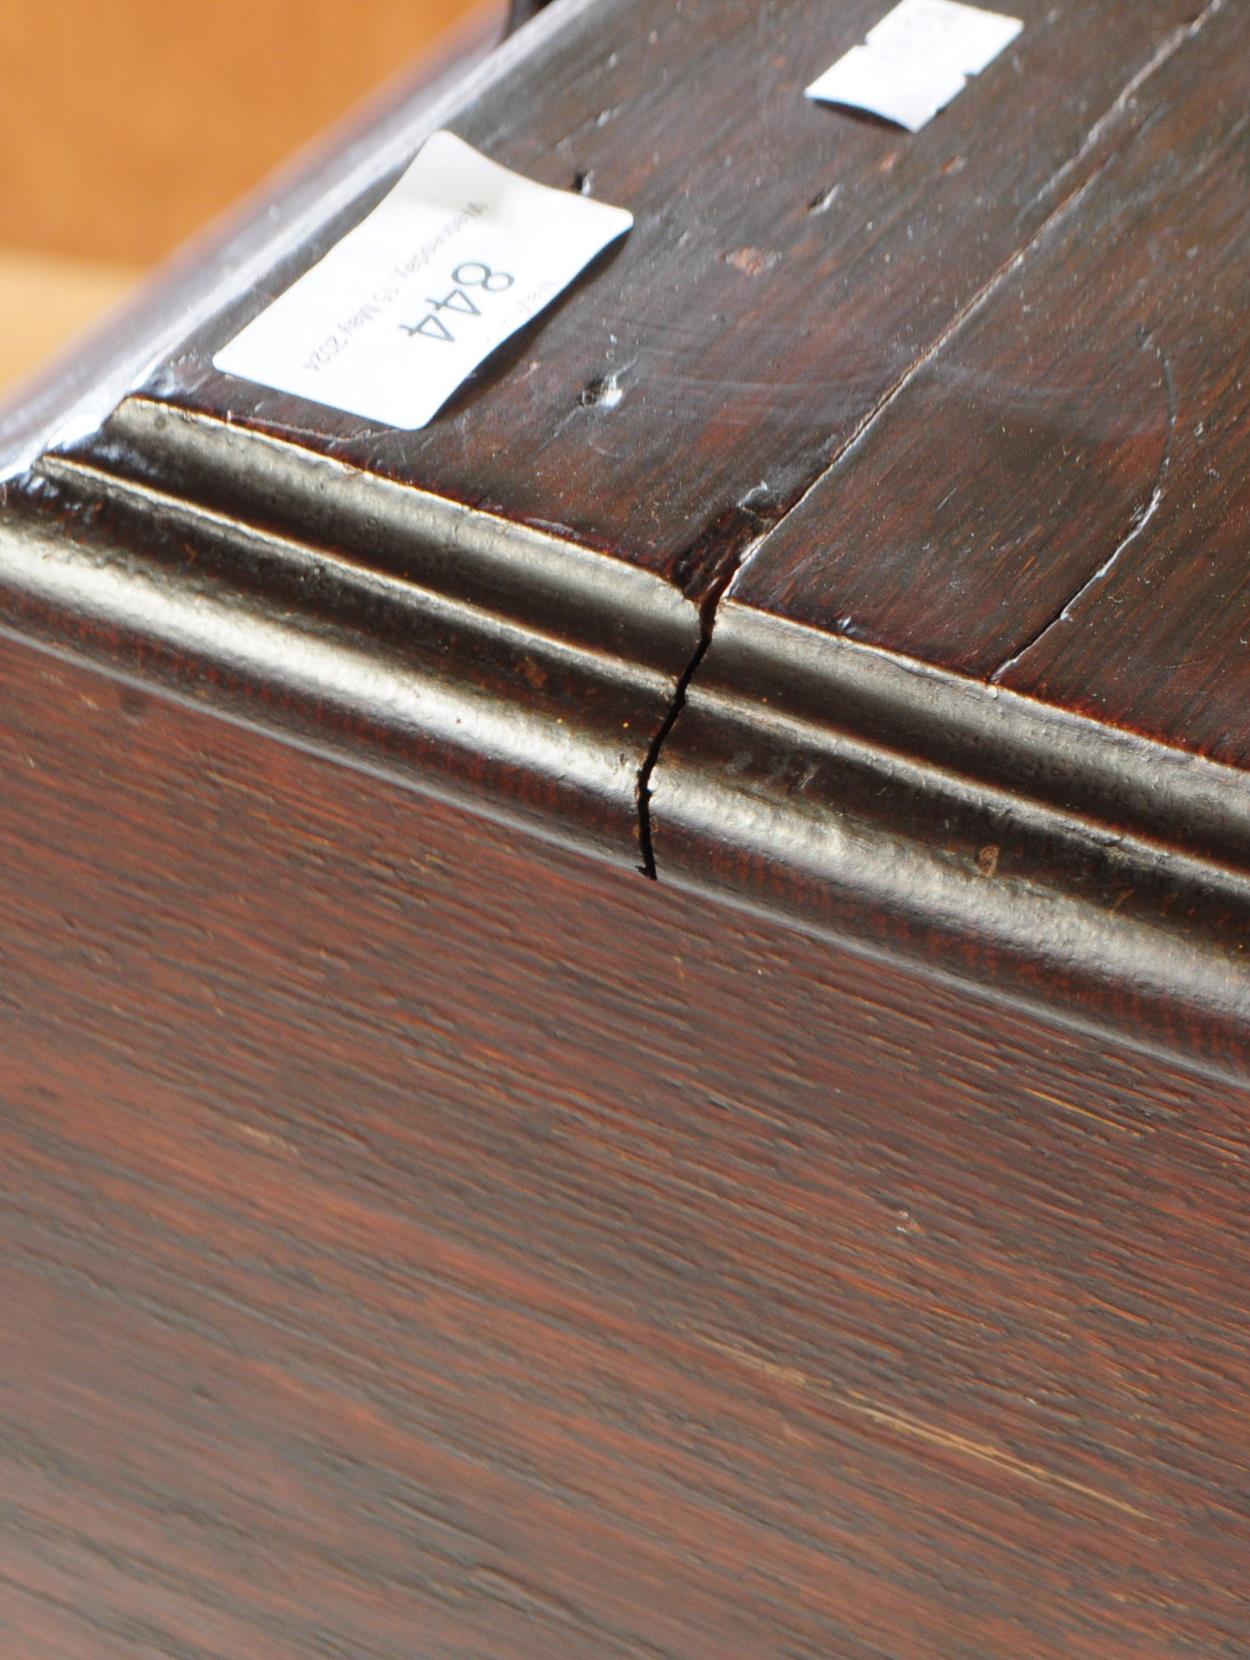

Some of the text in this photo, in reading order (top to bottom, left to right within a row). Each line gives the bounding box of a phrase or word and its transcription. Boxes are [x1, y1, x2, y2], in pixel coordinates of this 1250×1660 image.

[372, 283, 400, 304] 15
[398, 260, 516, 343] 844
[336, 303, 383, 335] May
[301, 335, 348, 372] 2024
